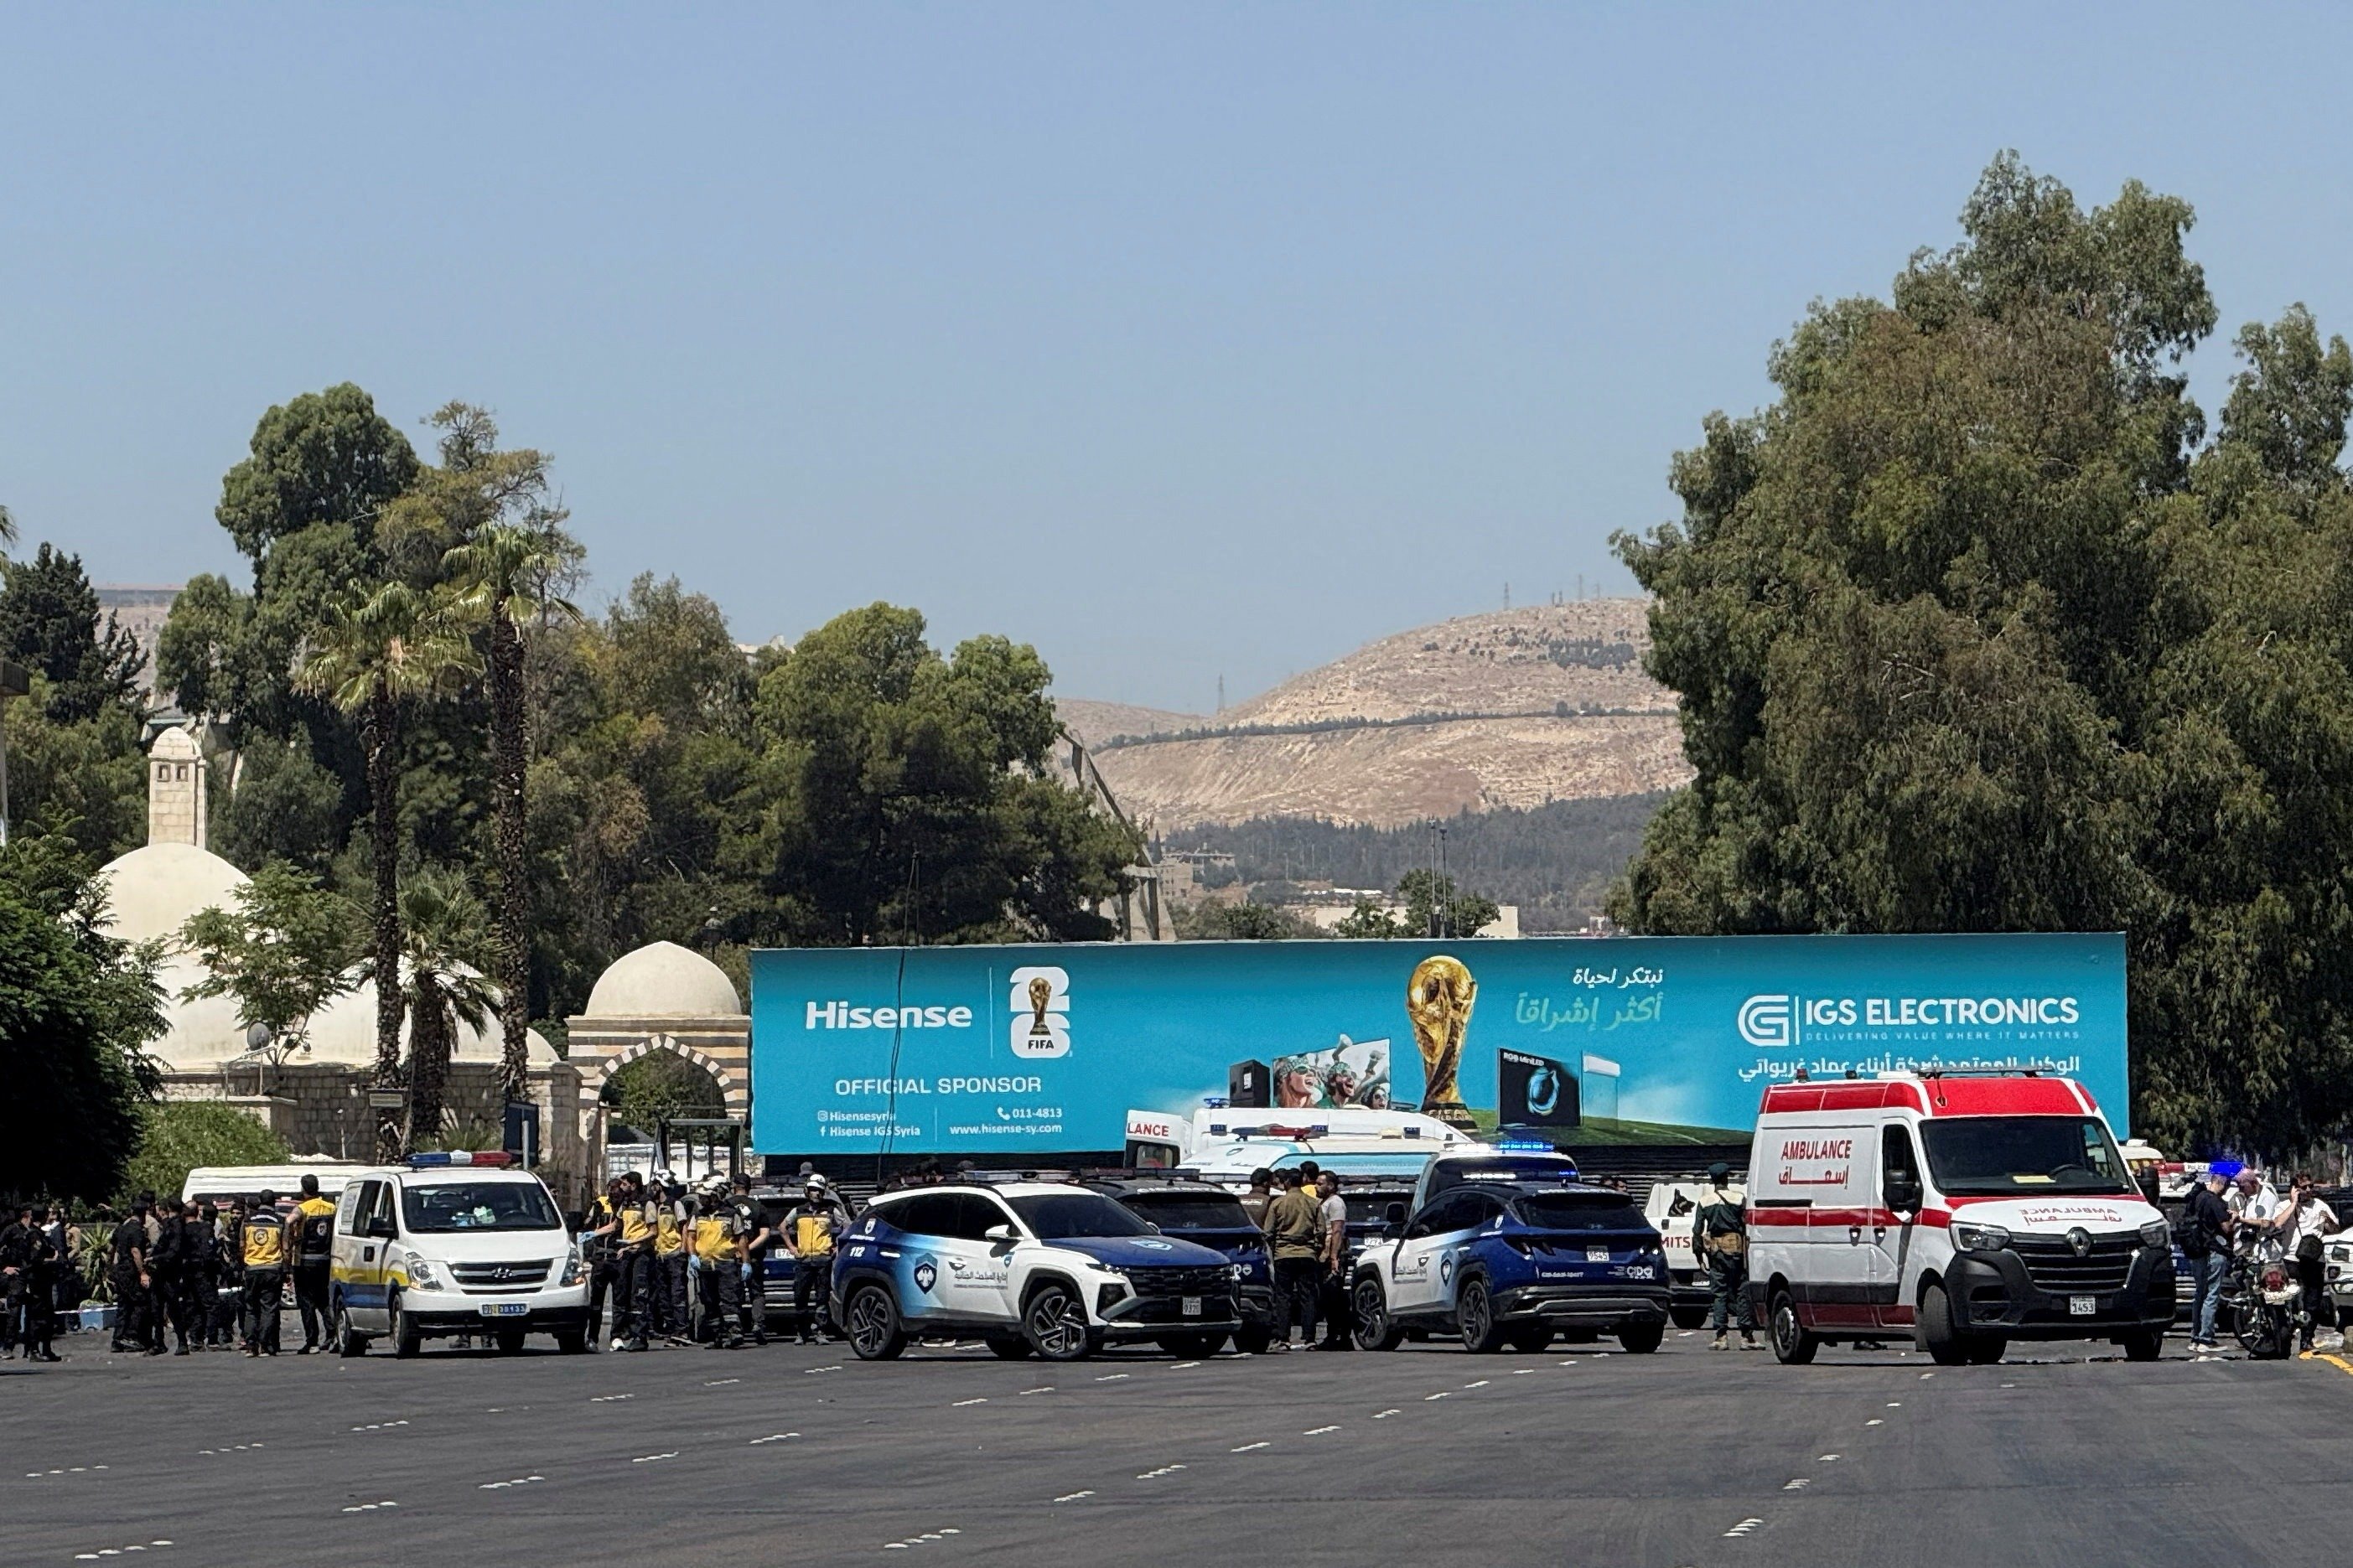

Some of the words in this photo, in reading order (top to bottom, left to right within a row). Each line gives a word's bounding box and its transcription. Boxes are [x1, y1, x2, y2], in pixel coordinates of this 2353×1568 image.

[1573, 967, 1617, 989] لحياة
[1617, 966, 1664, 989] نبتكر
[806, 1001, 972, 1030] Hisense
[1602, 991, 1664, 1031] أكثر
[1805, 998, 1857, 1026] IGS
[1866, 996, 2080, 1026] ELECTRONICS
[1028, 1039, 1055, 1050] FIFA
[1805, 1031, 1889, 1042] DELIVERING
[1895, 1032, 1937, 1040] VALUE
[1946, 1032, 1991, 1040] WHERE
[1998, 1032, 2011, 1040] IT
[2019, 1031, 2080, 1040] MATTERS
[834, 1078, 931, 1096] OFFICIAL
[937, 1076, 1042, 1094] SPONSOR
[1012, 1107, 1063, 1120] 011-4813
[829, 1126, 871, 1137] Hisense
[873, 1126, 892, 1136] IGS
[894, 1126, 920, 1138] Syria
[949, 1123, 1062, 1136] www.hisense-sy.com
[1780, 1139, 1853, 1161] AMBULANCE
[1778, 1164, 1850, 1190] إسعاف
[2071, 1302, 2095, 1314] 1453
